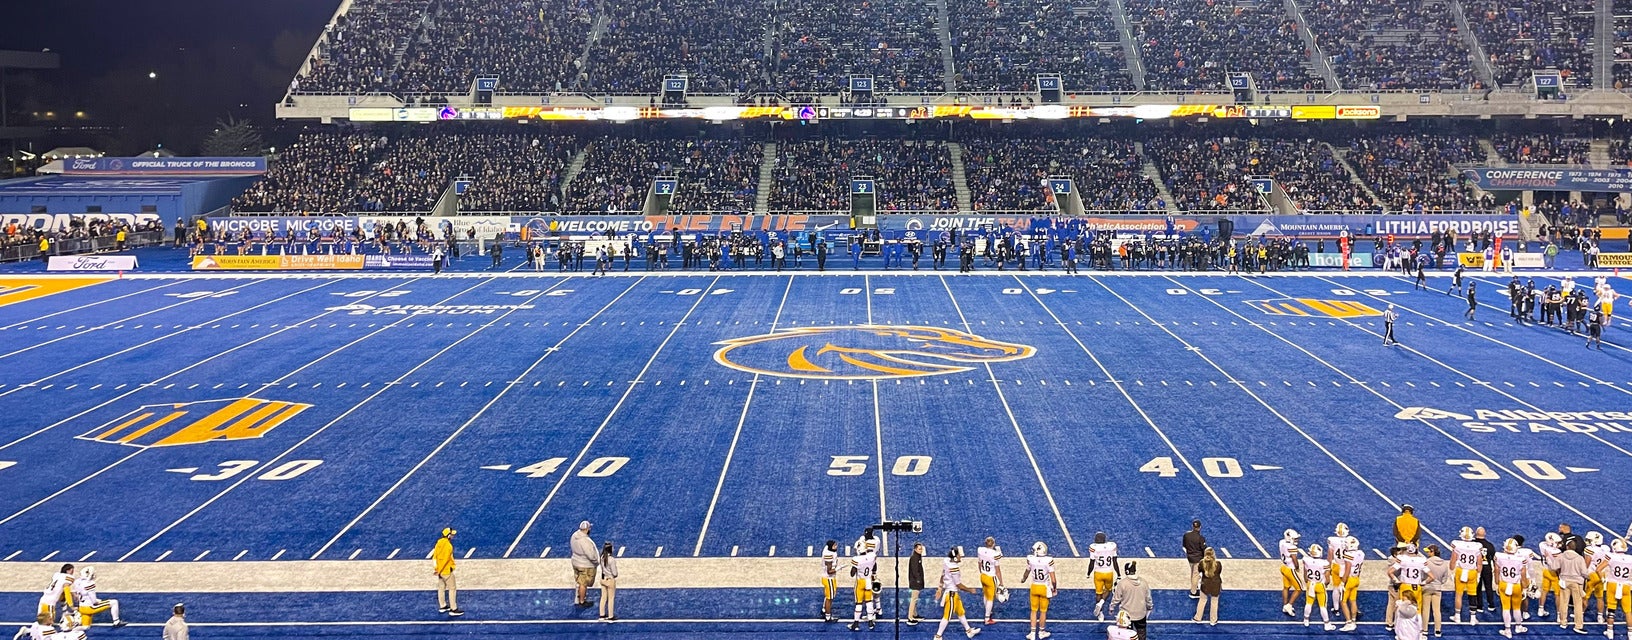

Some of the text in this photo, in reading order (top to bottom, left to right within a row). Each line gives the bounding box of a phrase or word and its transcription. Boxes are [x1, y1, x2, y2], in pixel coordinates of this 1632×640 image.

[72, 159, 97, 170] Ford
[1486, 170, 1563, 180] CONFERENCE
[212, 219, 278, 231] MICROBE
[556, 221, 653, 231] WELCOME TO
[930, 218, 963, 228] JOIN
[968, 218, 994, 228] THE
[1376, 220, 1518, 234] LITHIAFORDBOISE
[73, 256, 105, 269] Ford
[1475, 408, 1632, 420] Alberts
[190, 460, 324, 480] 30
[514, 456, 631, 478] 40
[826, 456, 932, 476] 50
[1139, 456, 1244, 478] 40
[1446, 459, 1566, 480] 30
[1098, 557, 1112, 567] 59
[1460, 554, 1475, 564] 88
[1034, 569, 1044, 580] 15
[1308, 569, 1320, 580] 29
[1406, 568, 1418, 579] 13
[1502, 566, 1516, 578] 86
[1614, 566, 1630, 578] 82
